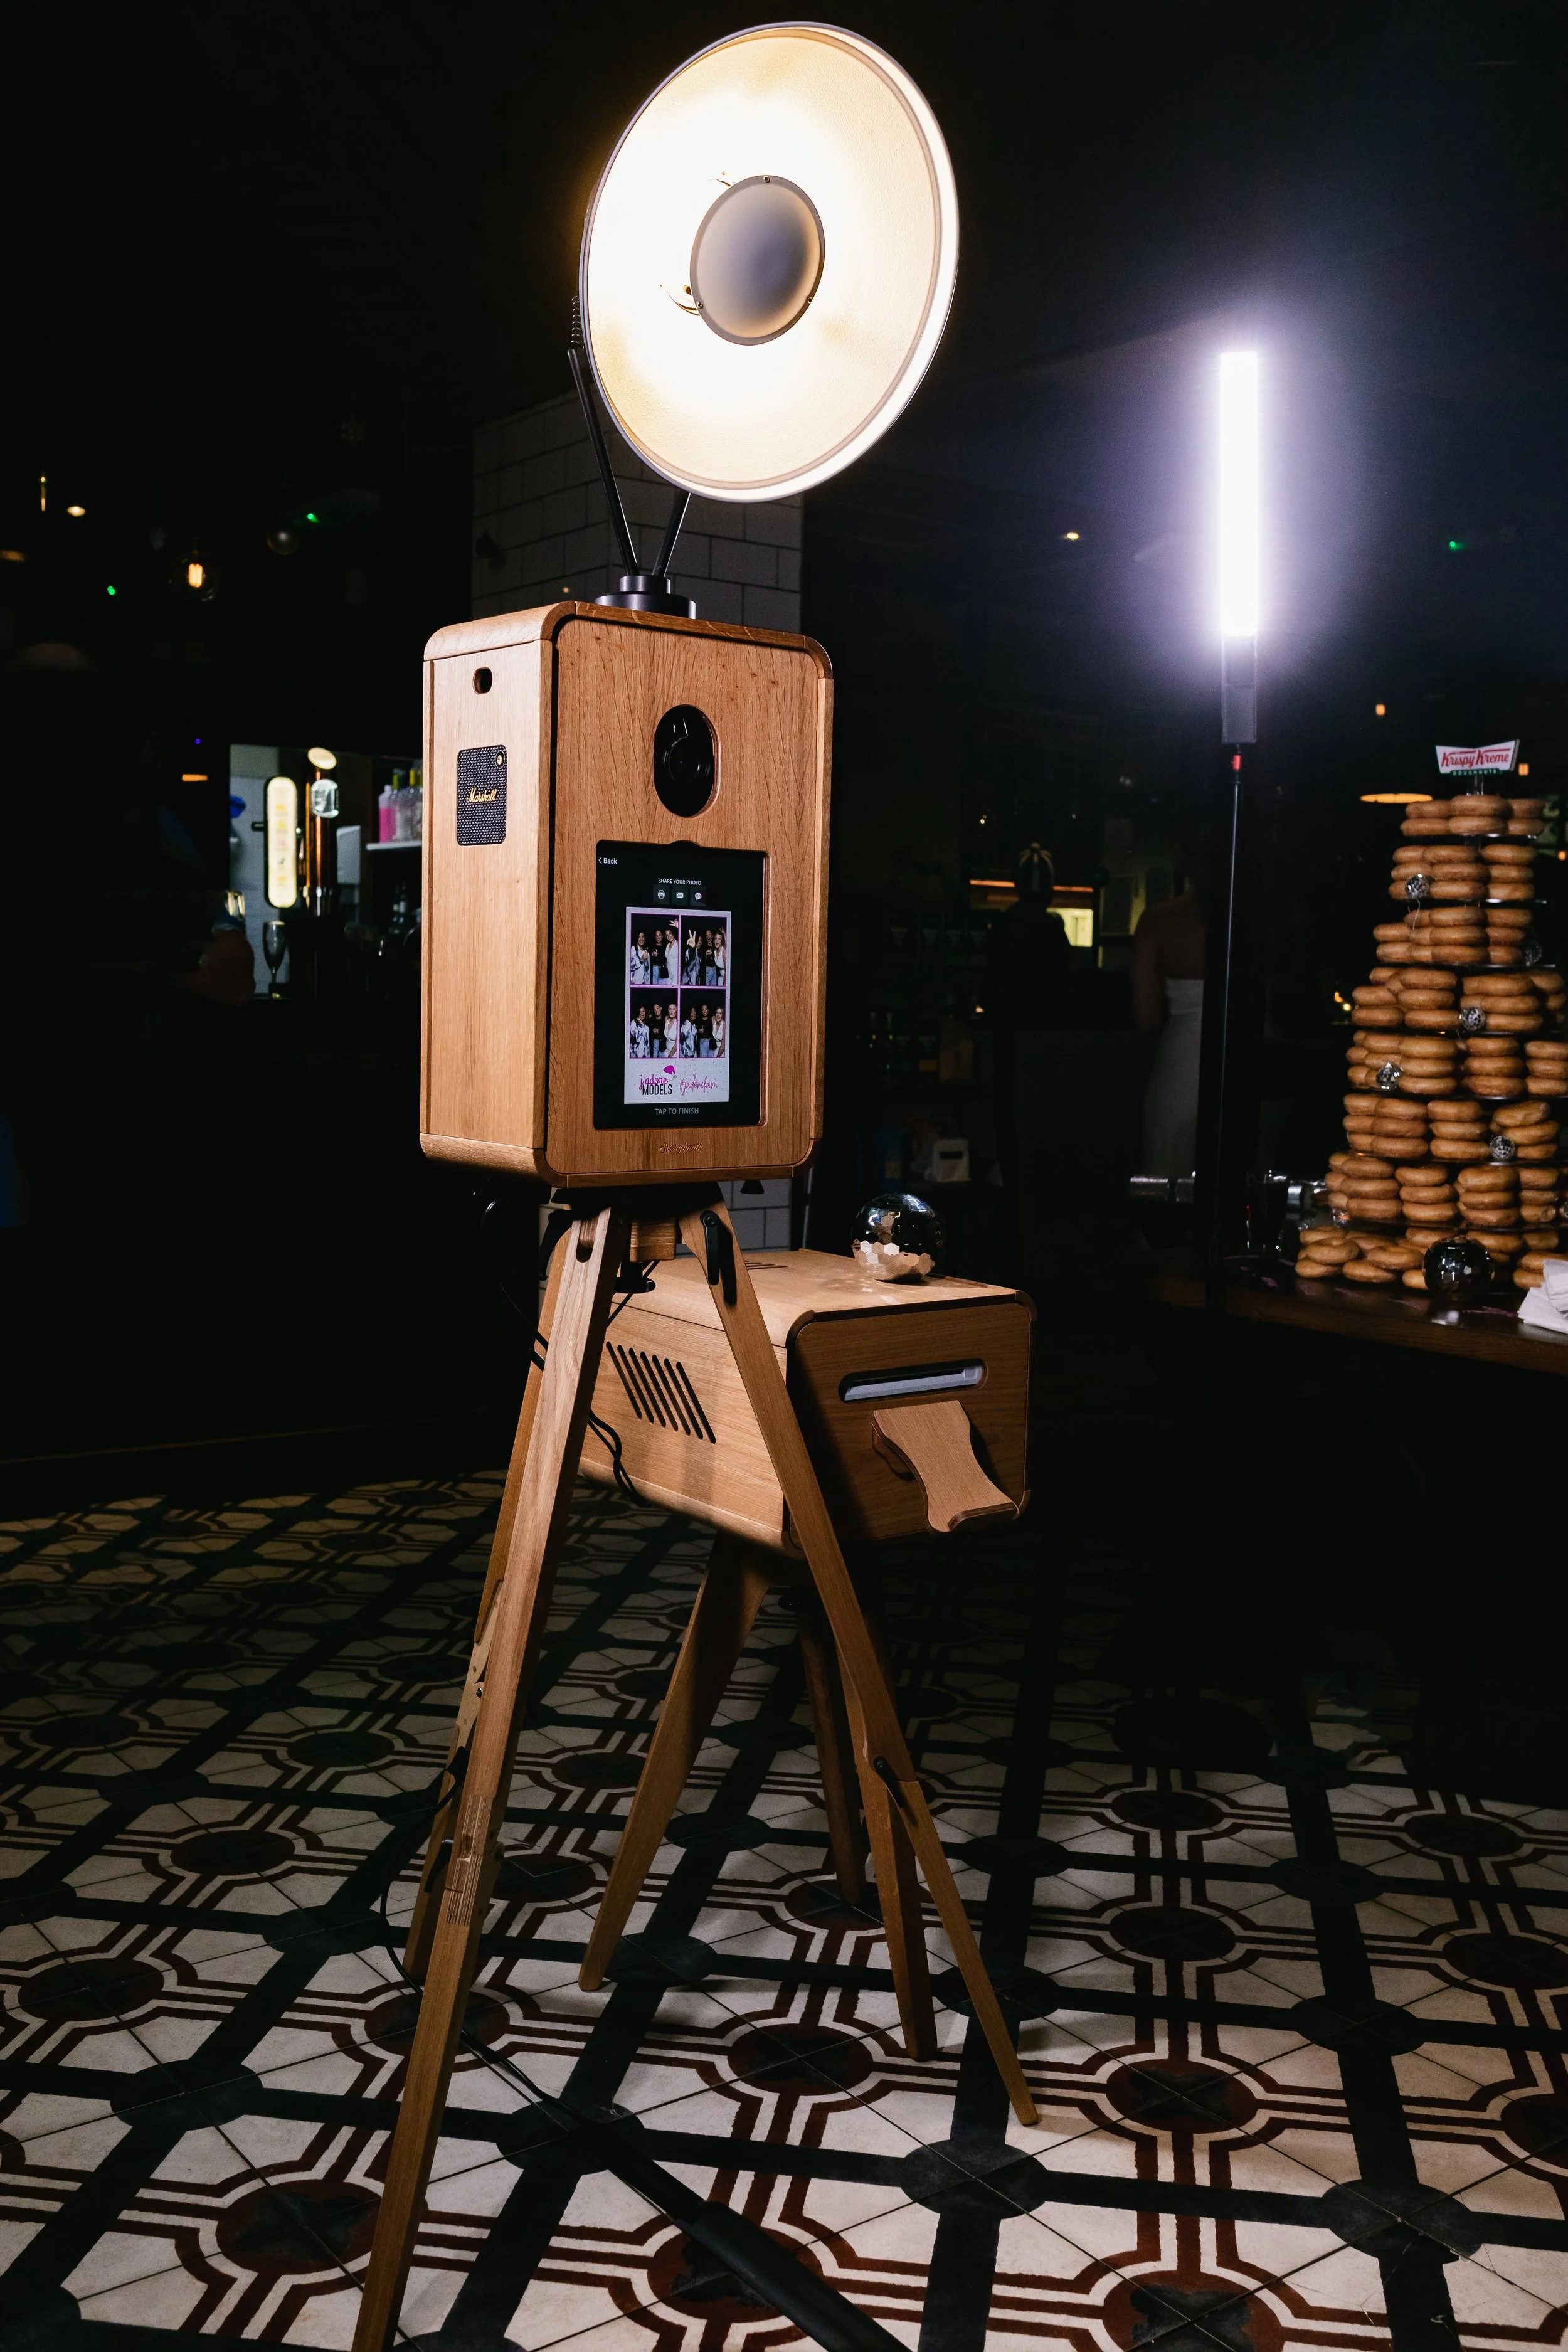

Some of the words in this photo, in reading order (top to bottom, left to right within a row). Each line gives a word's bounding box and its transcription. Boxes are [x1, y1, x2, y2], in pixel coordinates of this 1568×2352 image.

[1441, 750, 1476, 768] Krispy
[1475, 748, 1511, 765] Kreme
[466, 787, 497, 803] Marshall
[639, 1073, 669, 1090] j'adore
[642, 1084, 672, 1096] MODELS
[679, 1072, 719, 1096] #jadorefam
